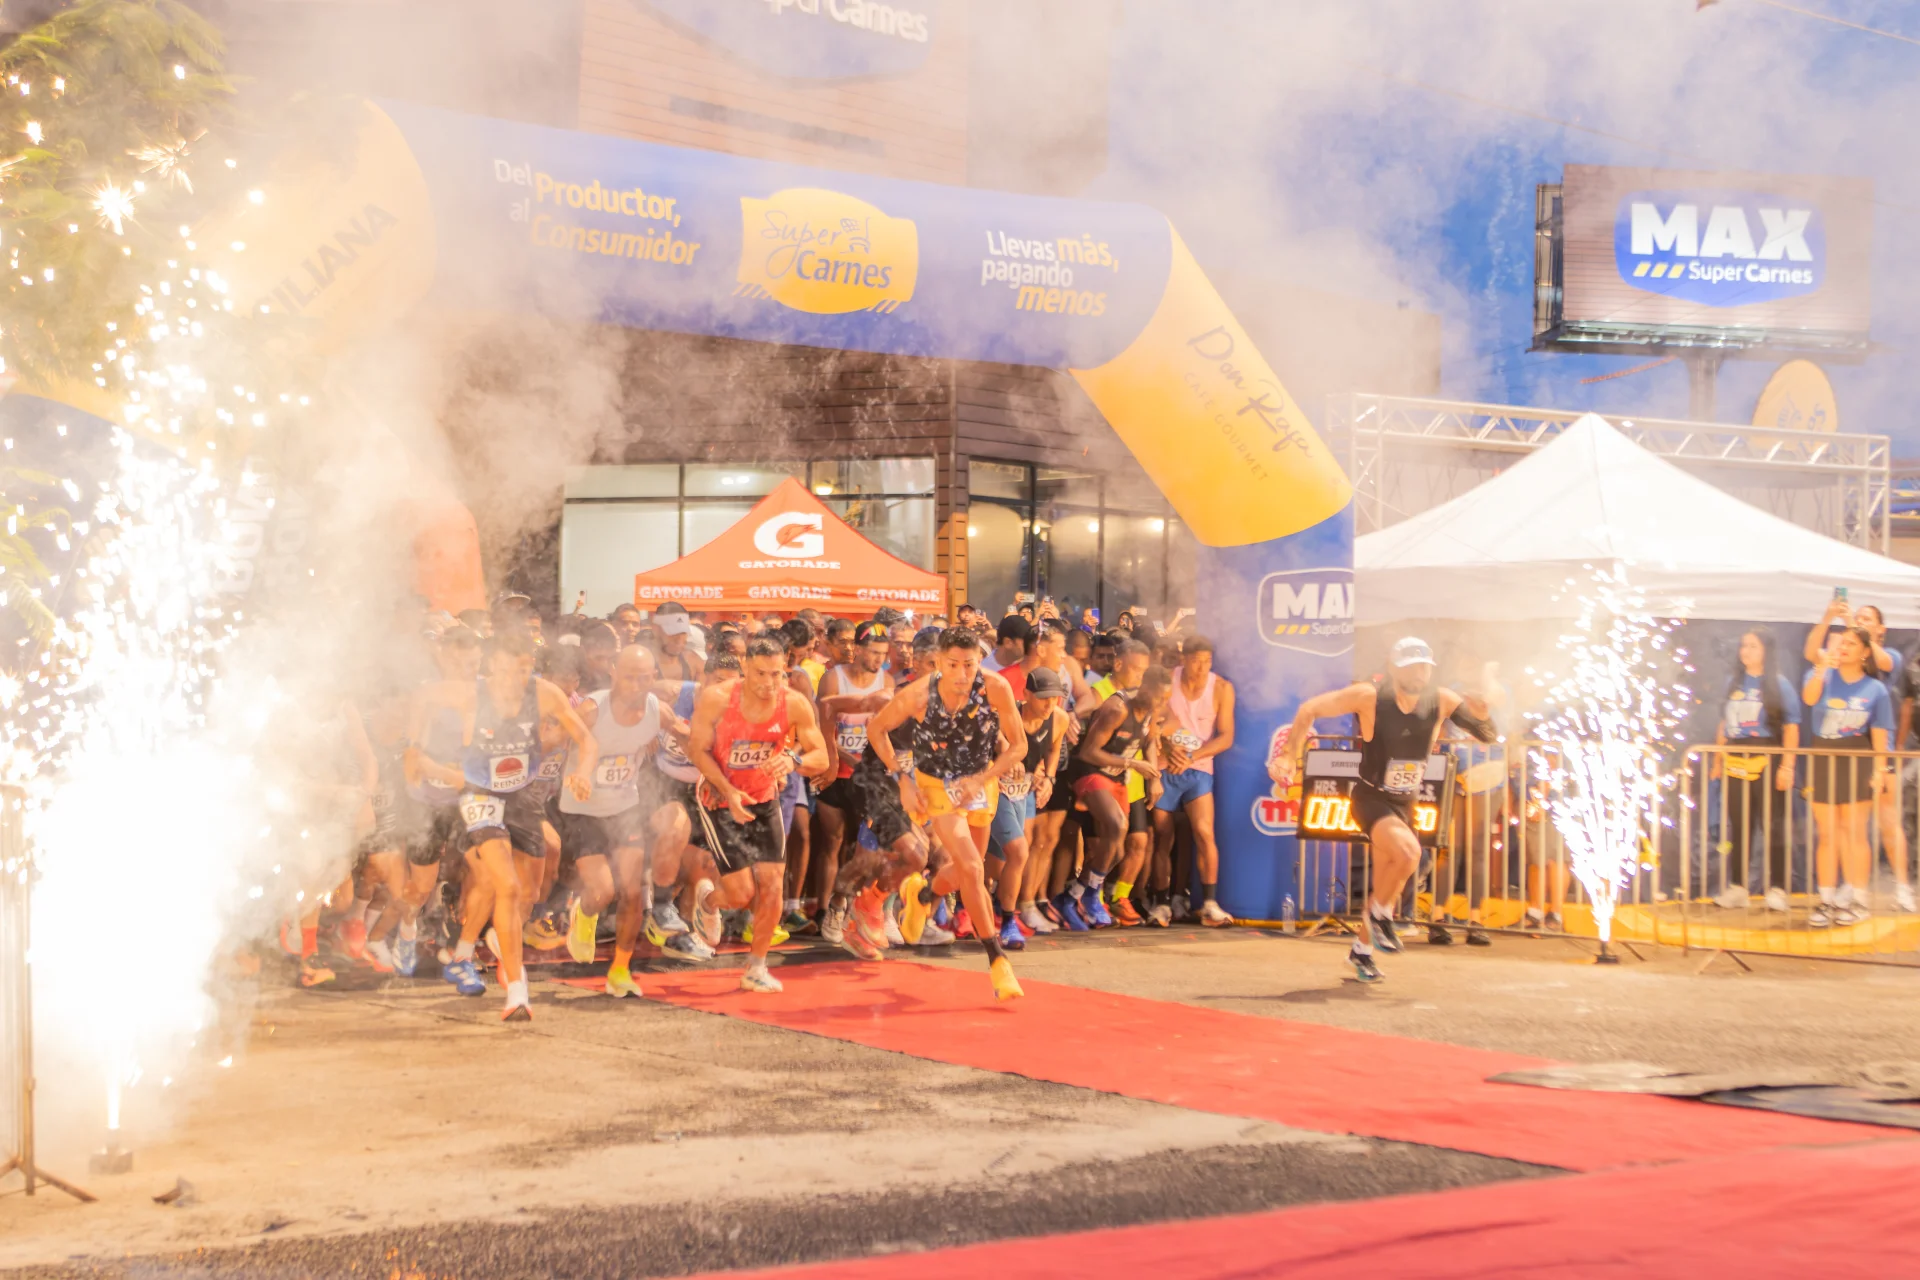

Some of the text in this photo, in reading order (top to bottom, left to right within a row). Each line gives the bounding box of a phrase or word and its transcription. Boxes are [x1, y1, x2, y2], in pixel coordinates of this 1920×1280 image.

[494, 159, 681, 228] Del Productor,
[510, 197, 700, 265] al Consumidor
[760, 210, 843, 280] Super
[986, 230, 1056, 262] Llevas
[1631, 203, 1814, 261] MAX
[796, 250, 893, 289] Carnes
[981, 258, 1074, 290] pagando
[1015, 284, 1107, 317] menos
[1186, 325, 1247, 391] Don
[1214, 413, 1269, 482] GOURMET
[738, 560, 841, 569] GATORADE
[639, 585, 724, 600] GATORADE
[748, 585, 832, 600] GATORADE
[856, 588, 940, 602] GATORADE
[733, 750, 771, 764] 1043
[1330, 760, 1361, 769] SAMSUN
[605, 768, 631, 782] 812
[467, 804, 496, 822] 872
